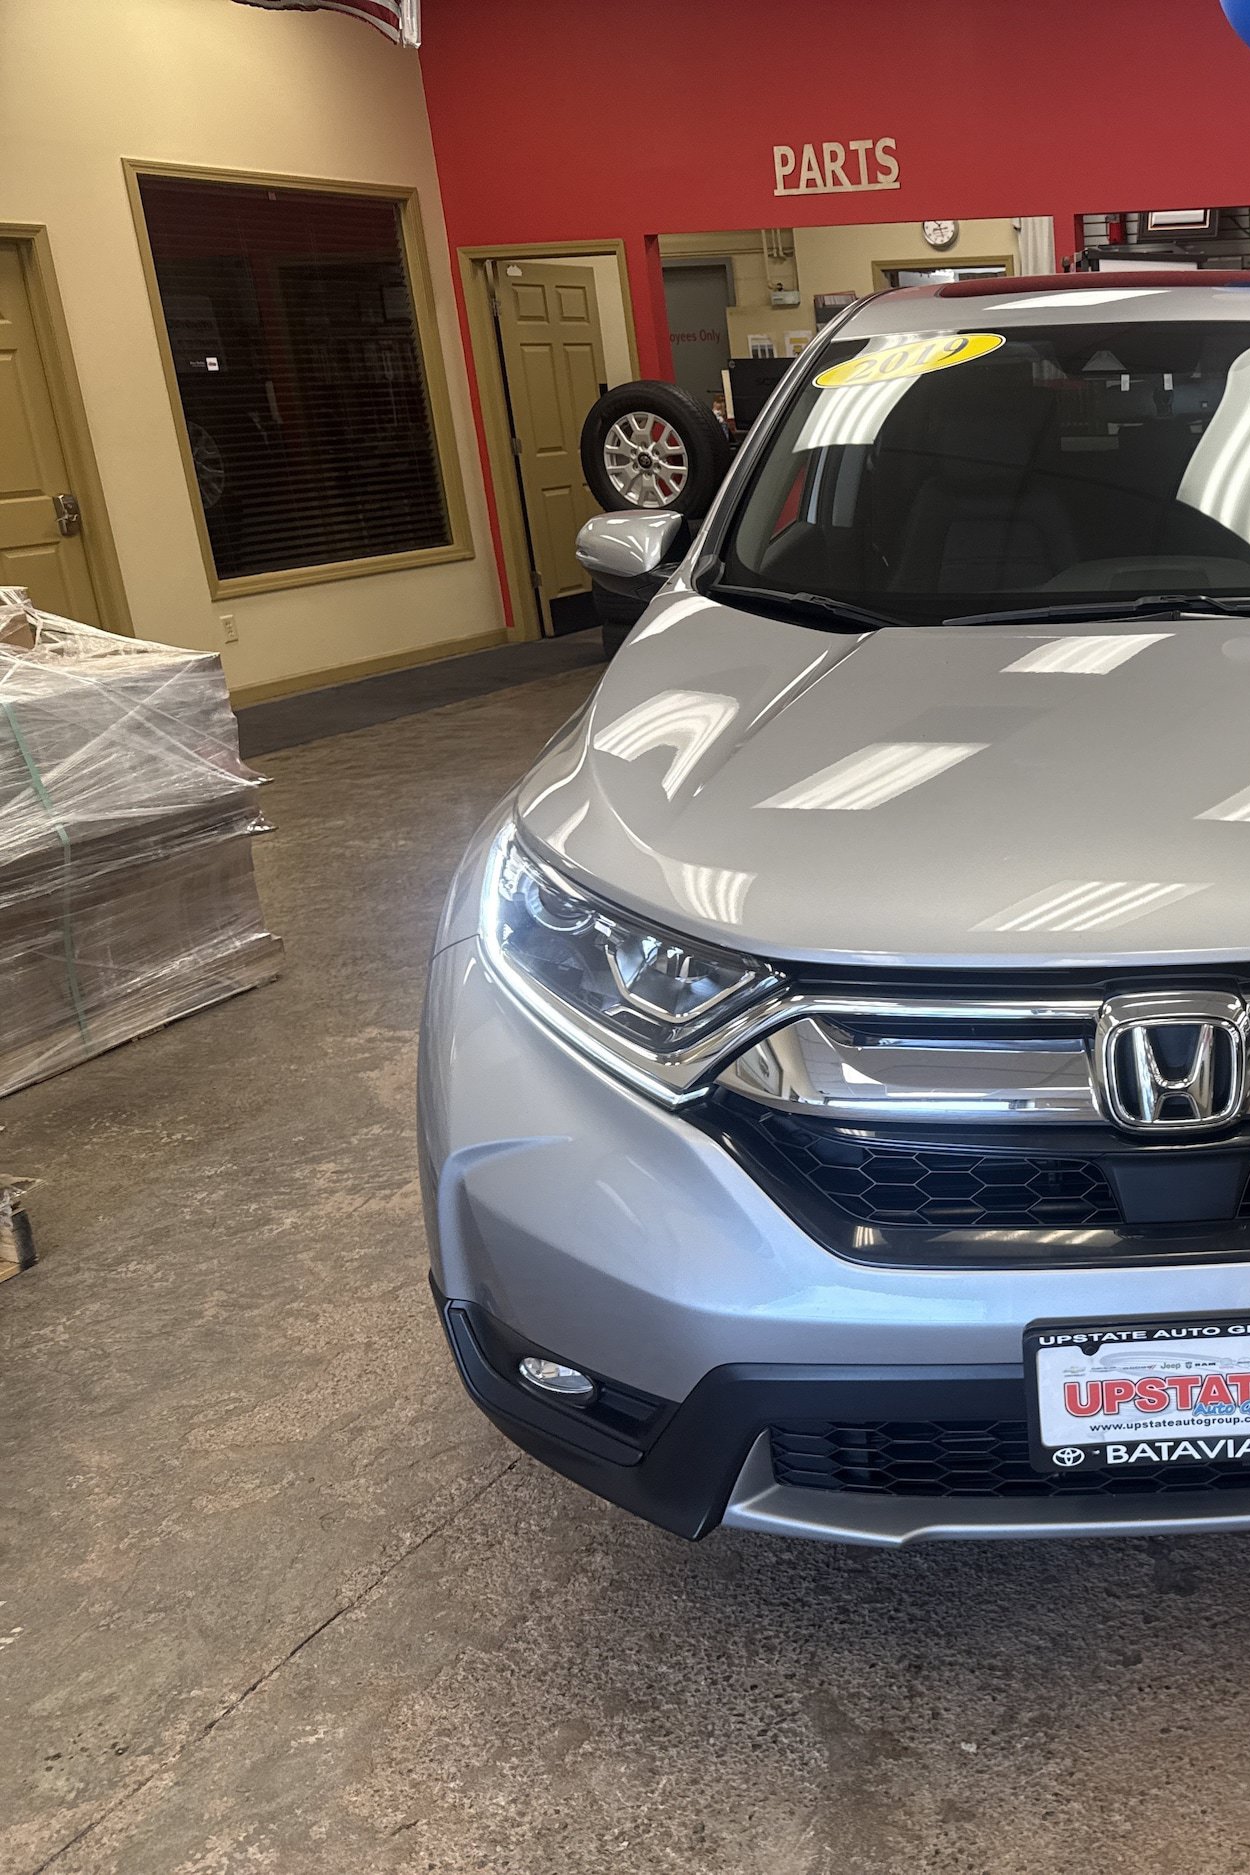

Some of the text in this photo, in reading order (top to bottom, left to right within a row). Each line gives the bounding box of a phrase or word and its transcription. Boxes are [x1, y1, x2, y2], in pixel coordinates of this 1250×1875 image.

[773, 137, 900, 193] PARTS
[700, 329, 720, 345] Only
[846, 337, 969, 384] 2019
[1039, 1330, 1147, 1346] UPSTATE
[1153, 1325, 1221, 1339] AUTO
[1160, 1361, 1181, 1370] Jeep
[1193, 1402, 1235, 1416] Auto
